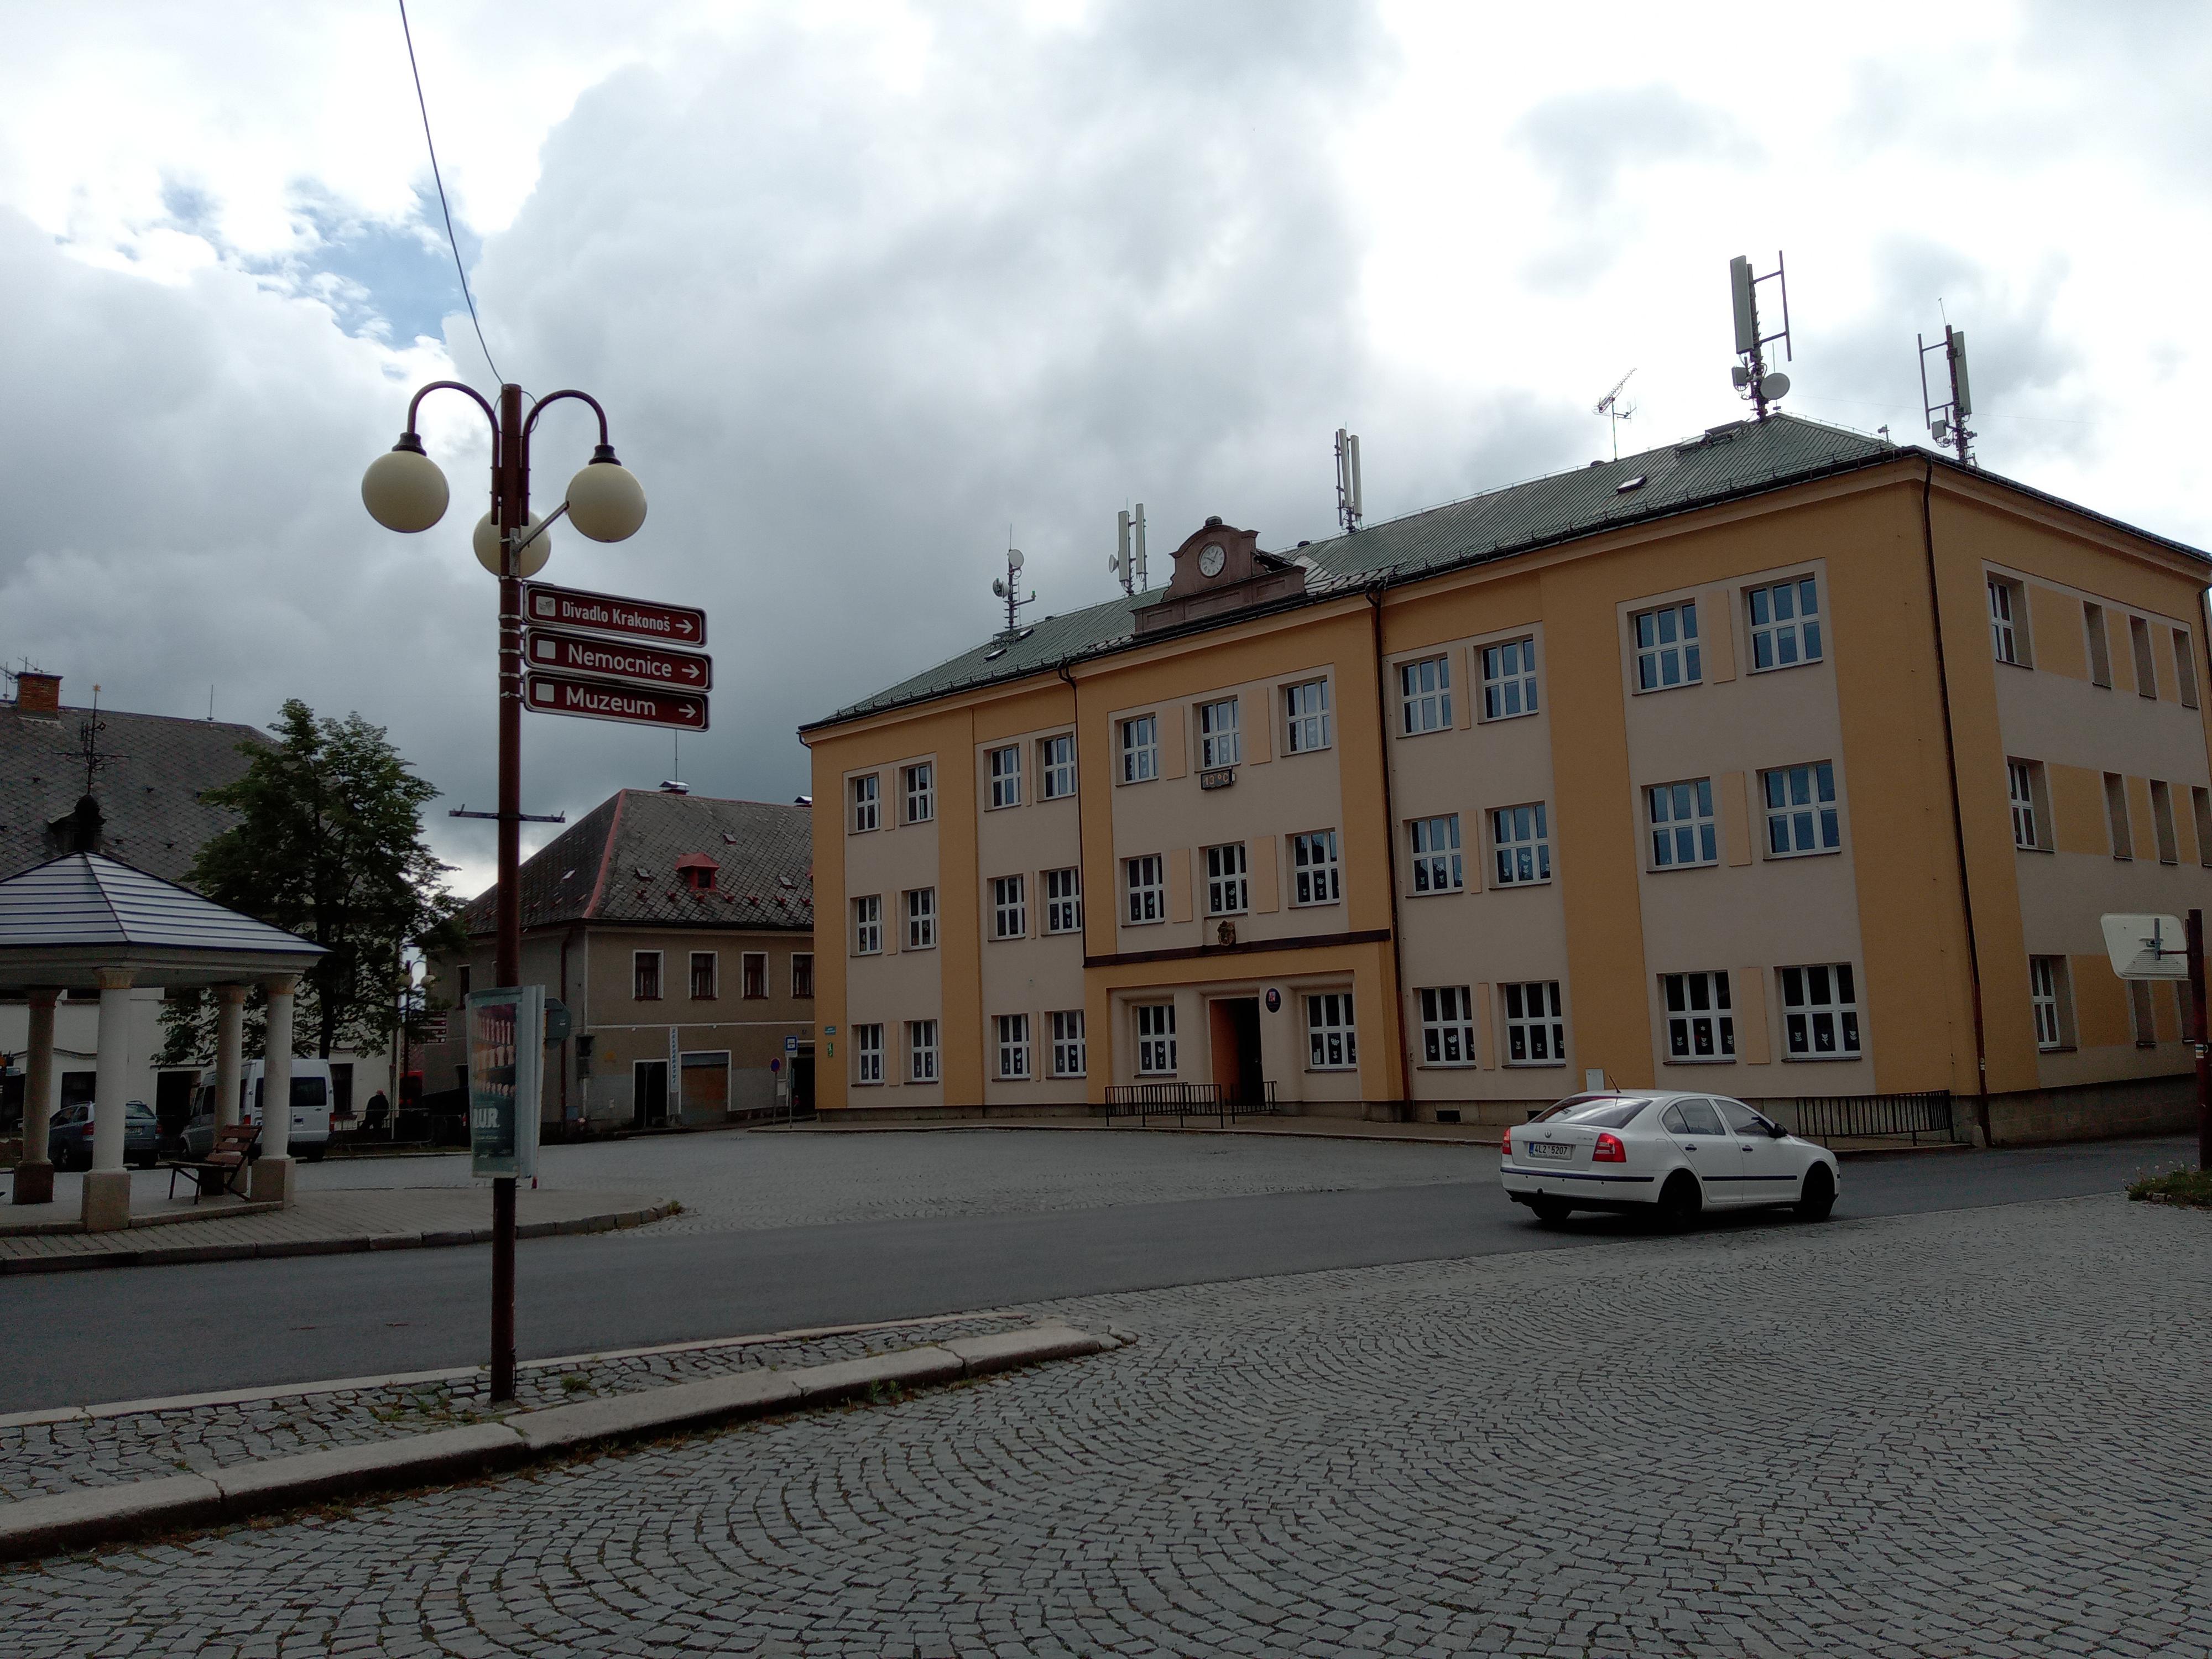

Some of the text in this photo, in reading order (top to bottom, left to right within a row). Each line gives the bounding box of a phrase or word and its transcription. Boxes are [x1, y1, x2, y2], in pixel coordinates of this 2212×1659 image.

[562, 601, 670, 632] Divadlo Krakonoš
[568, 643, 672, 677] Nemocnice
[566, 686, 656, 716] Muzeum
[1203, 775, 1214, 785] 13
[1535, 1144, 1568, 1155] 4L2 5207
